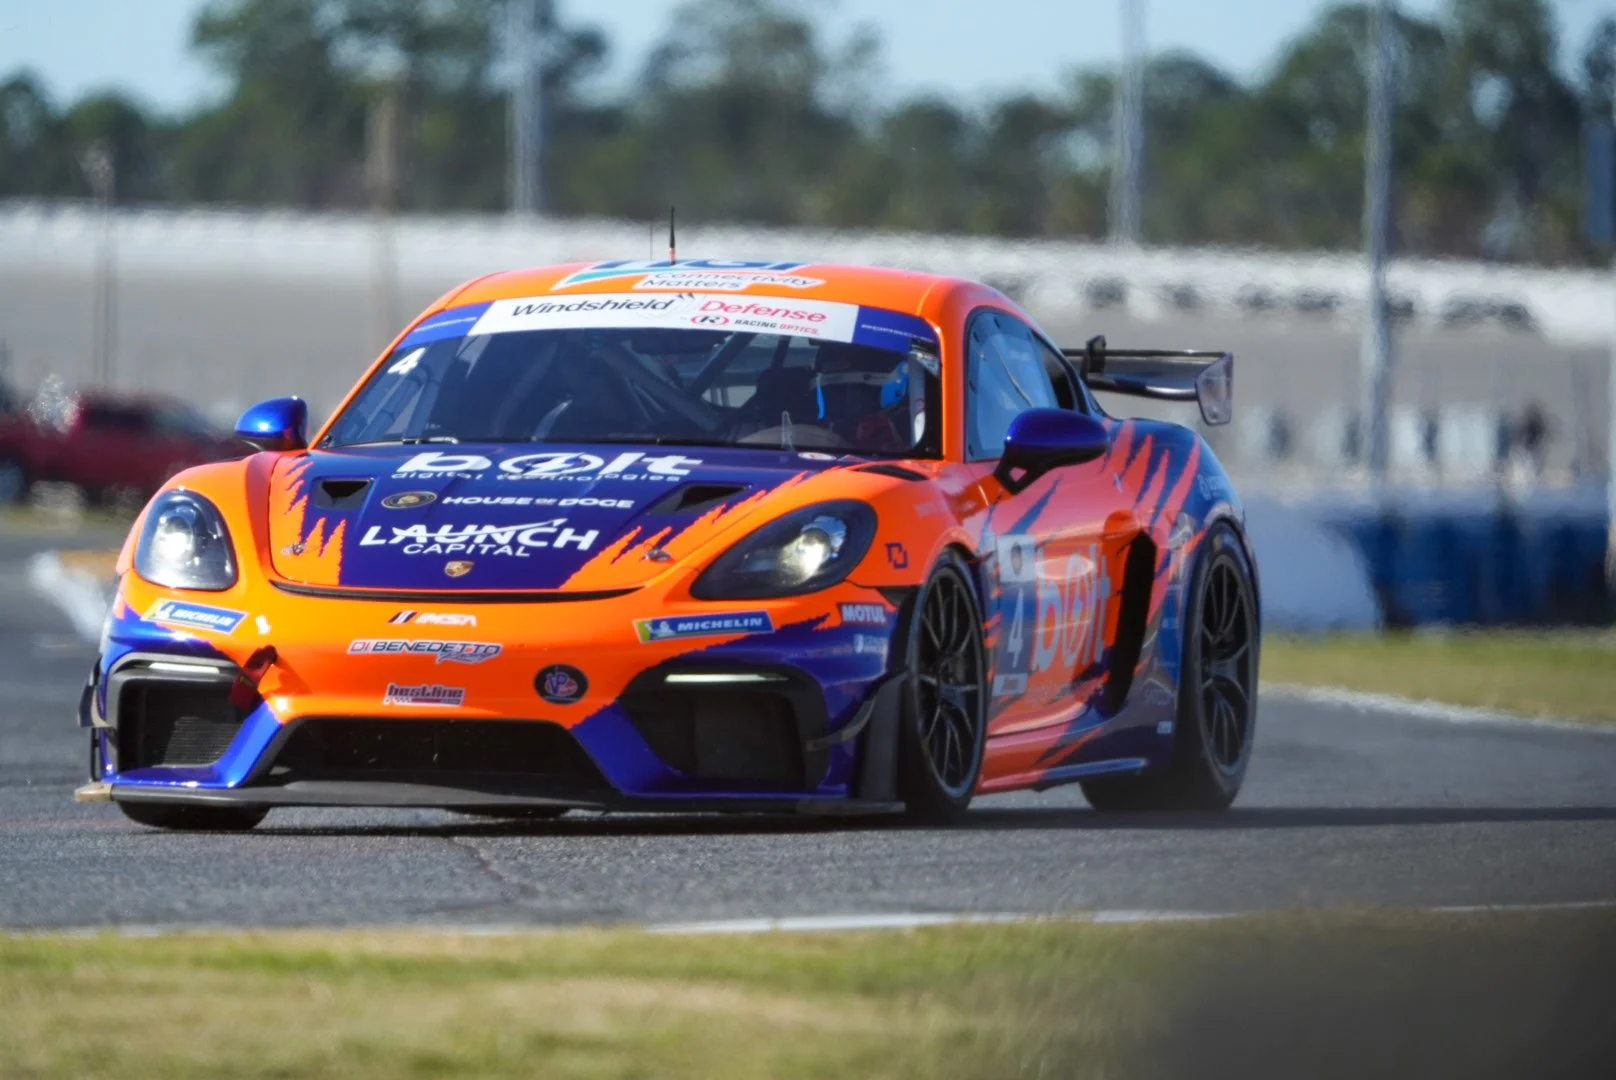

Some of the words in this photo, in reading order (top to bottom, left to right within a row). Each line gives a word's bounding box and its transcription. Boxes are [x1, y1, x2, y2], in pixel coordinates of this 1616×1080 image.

[642, 279, 742, 289] Matters
[655, 272, 817, 286] Connectivity
[512, 299, 674, 317] Windshield
[701, 300, 827, 322] Defense
[734, 319, 778, 329] RACING
[779, 324, 819, 335] OPTICS
[387, 347, 426, 375] 4
[397, 452, 703, 476] bolt
[442, 496, 534, 505] HOUSE
[558, 498, 635, 508] DOGE
[359, 518, 600, 550] LAUNCH
[403, 543, 531, 557] CAPITAL
[415, 612, 477, 627] IMSA
[842, 604, 886, 623] MOTUL
[677, 617, 764, 632] MICHELIN
[1007, 588, 1024, 668] 4
[372, 641, 502, 655] BENEDETTO
